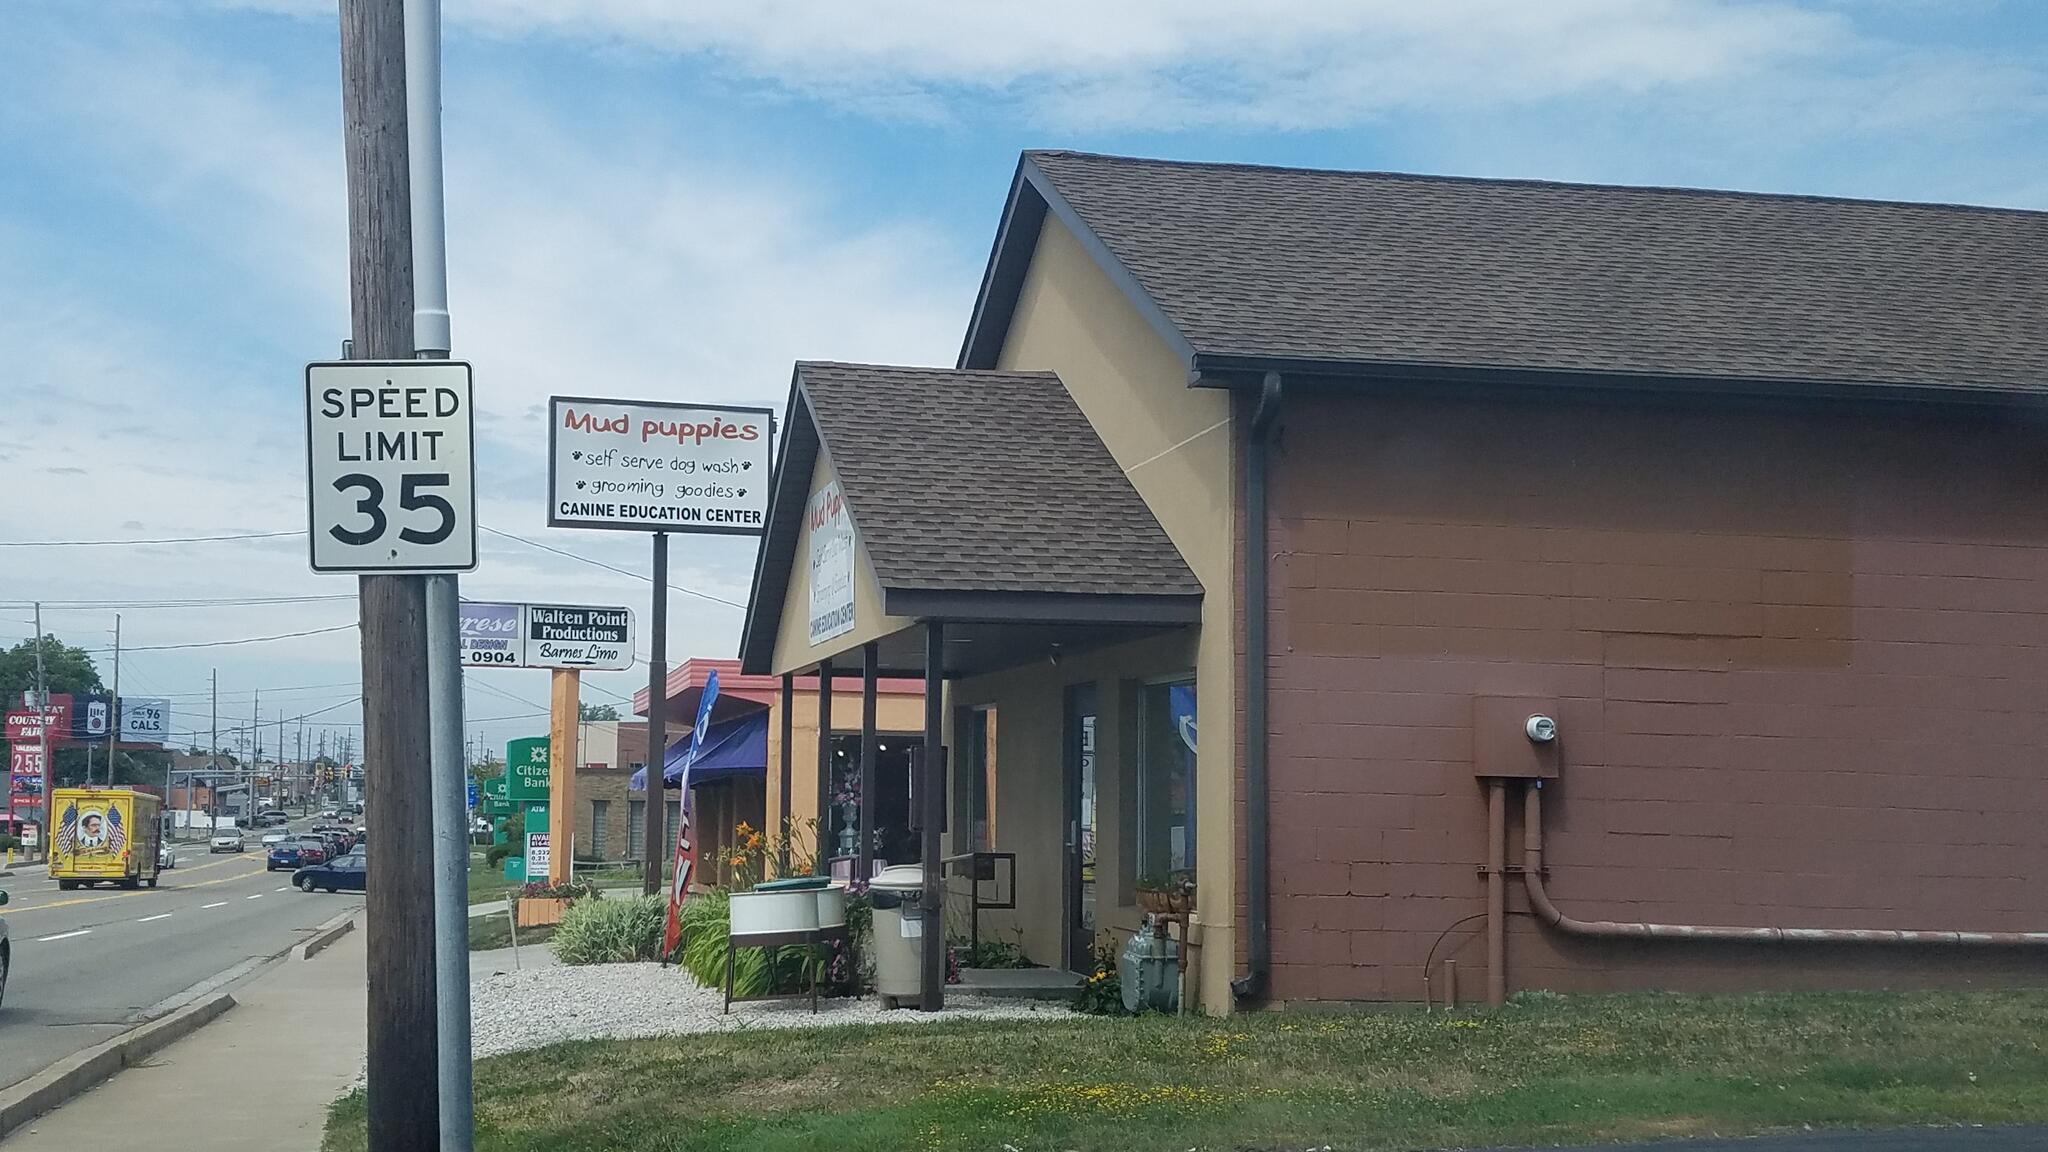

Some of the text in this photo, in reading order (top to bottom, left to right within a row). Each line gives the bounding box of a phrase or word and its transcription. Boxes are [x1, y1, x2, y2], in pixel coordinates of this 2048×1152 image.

[321, 388, 459, 418] SPEED
[564, 408, 759, 445] Mud puppies
[338, 431, 444, 462] LIMIT
[585, 448, 739, 474] self serve dog wash
[590, 478, 734, 499] grooming goodies
[329, 473, 456, 545] 35
[560, 501, 761, 524] CANINE EDUCATION CENTER
[460, 616, 517, 632] rese
[531, 609, 627, 627] Walten Point
[542, 625, 619, 641] Productions
[469, 639, 509, 651] DESIGN
[540, 642, 619, 660] Barnes Limo
[472, 651, 516, 664] 0904
[146, 708, 160, 720] 96
[131, 720, 162, 731] CALS.
[516, 765, 550, 776] Citize
[524, 777, 550, 788] Bank
[530, 805, 546, 813] ATM
